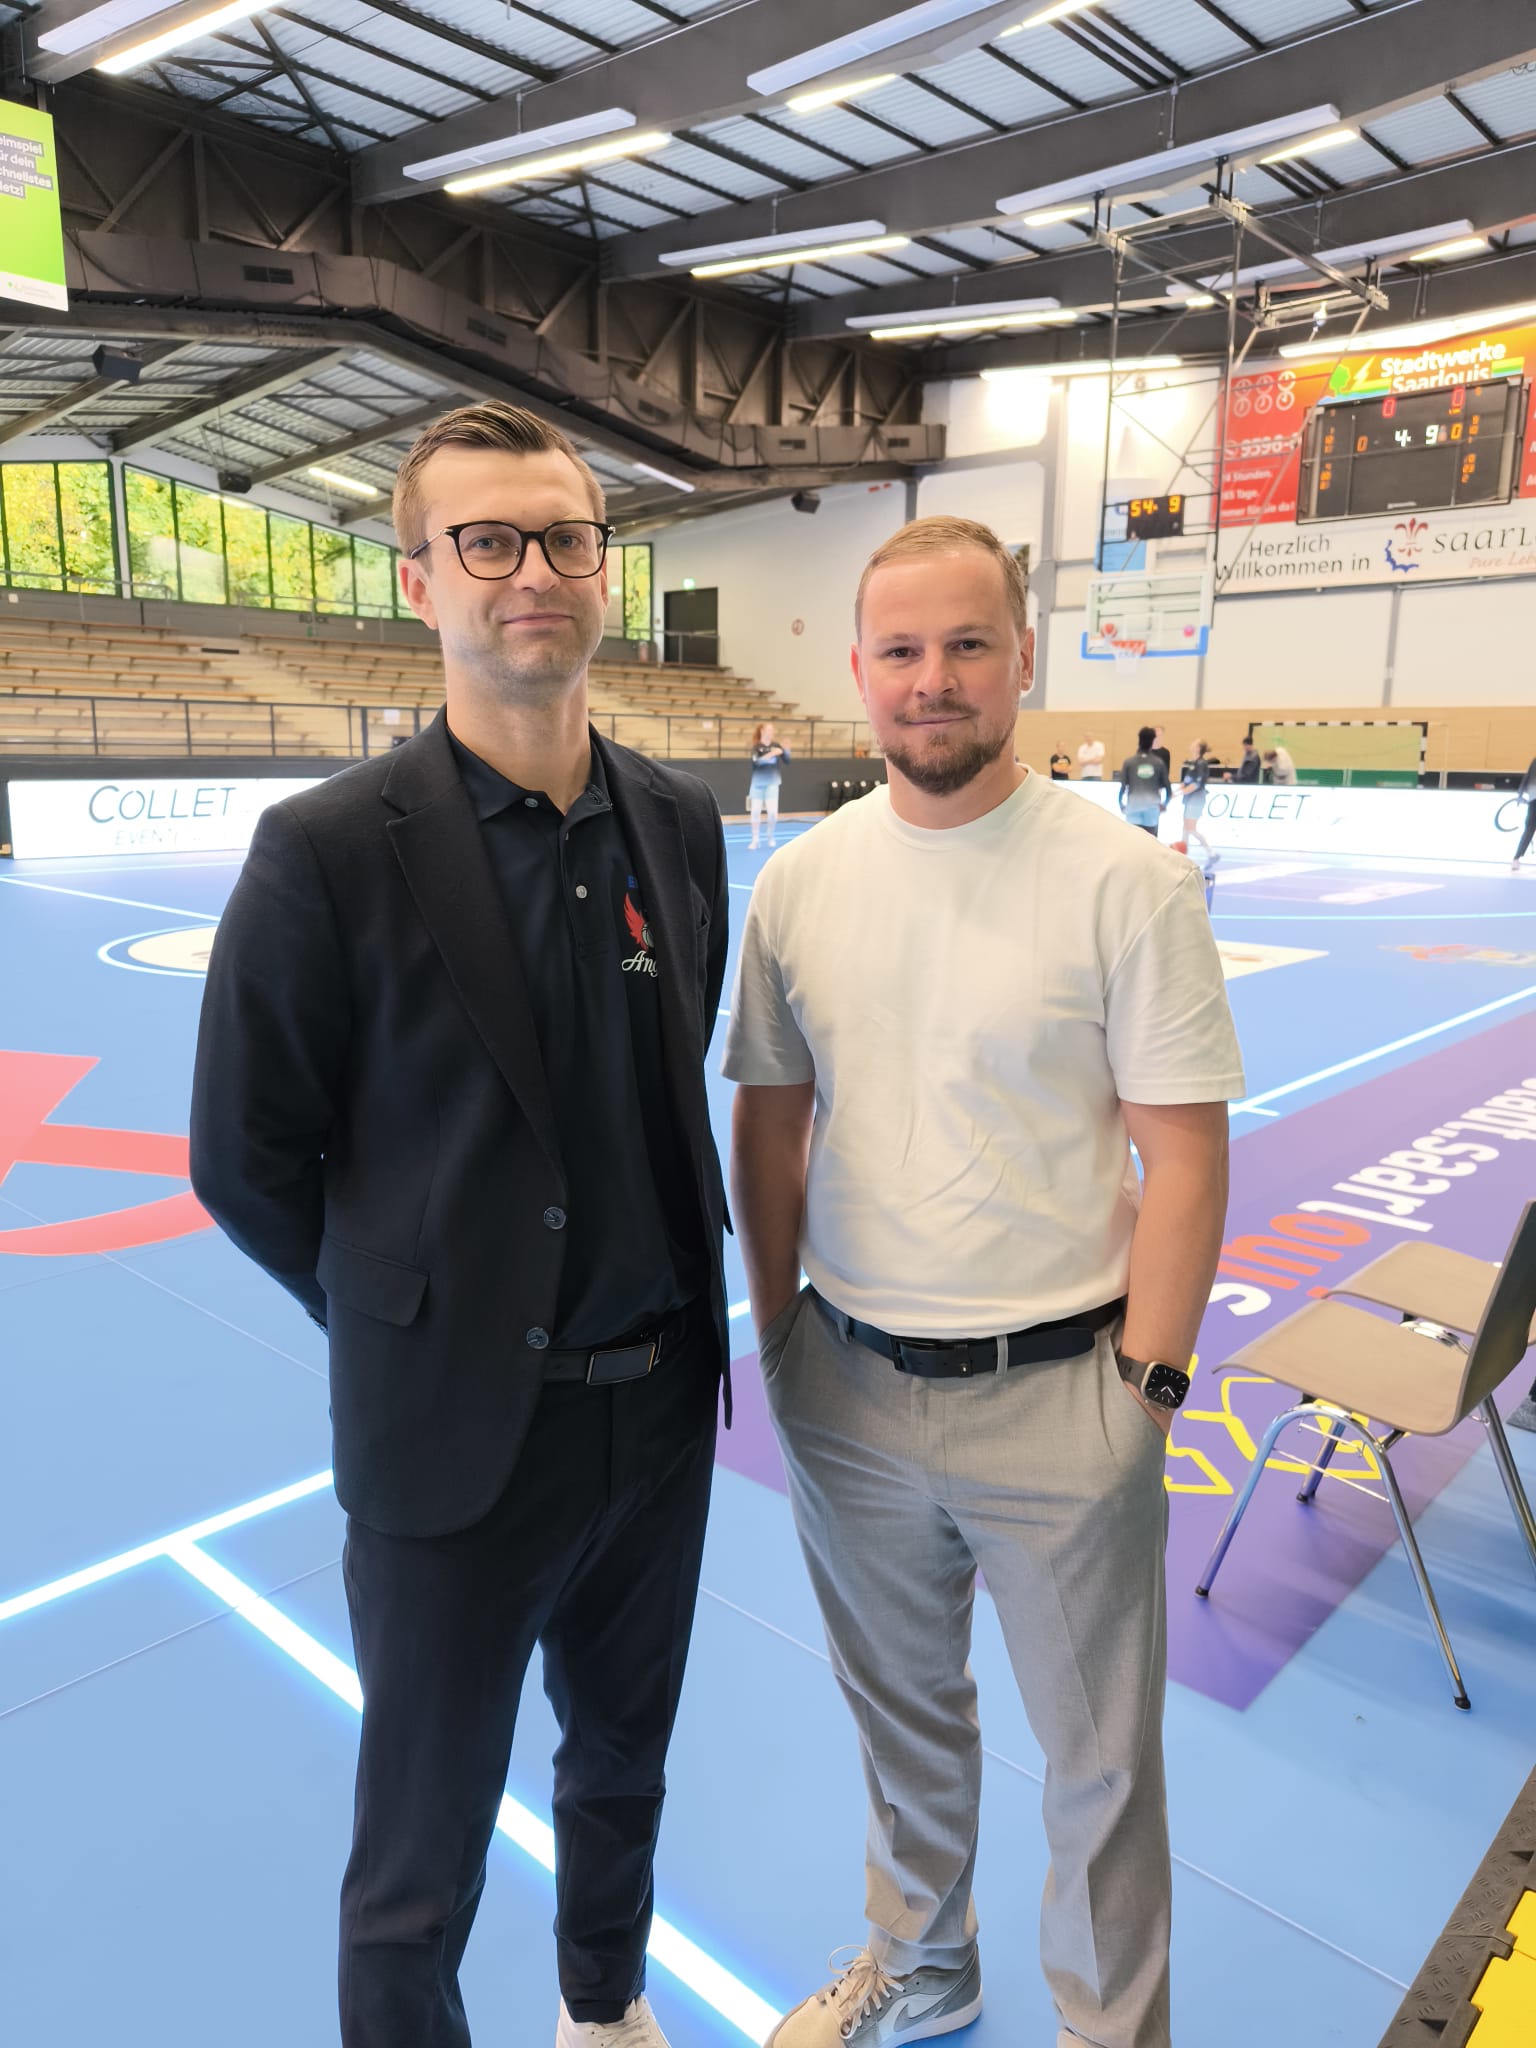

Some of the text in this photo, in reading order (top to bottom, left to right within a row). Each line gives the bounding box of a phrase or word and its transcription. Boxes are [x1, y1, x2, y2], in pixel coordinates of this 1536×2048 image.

[10, 154, 35, 169] dein
[1380, 340, 1507, 378] Stadtwerke
[1391, 363, 1490, 395] Saarlouis
[1249, 534, 1331, 557] Herzlich
[1215, 553, 1371, 581] Willkommen in
[89, 785, 237, 823] COLLET
[1207, 793, 1312, 821] OLLET
